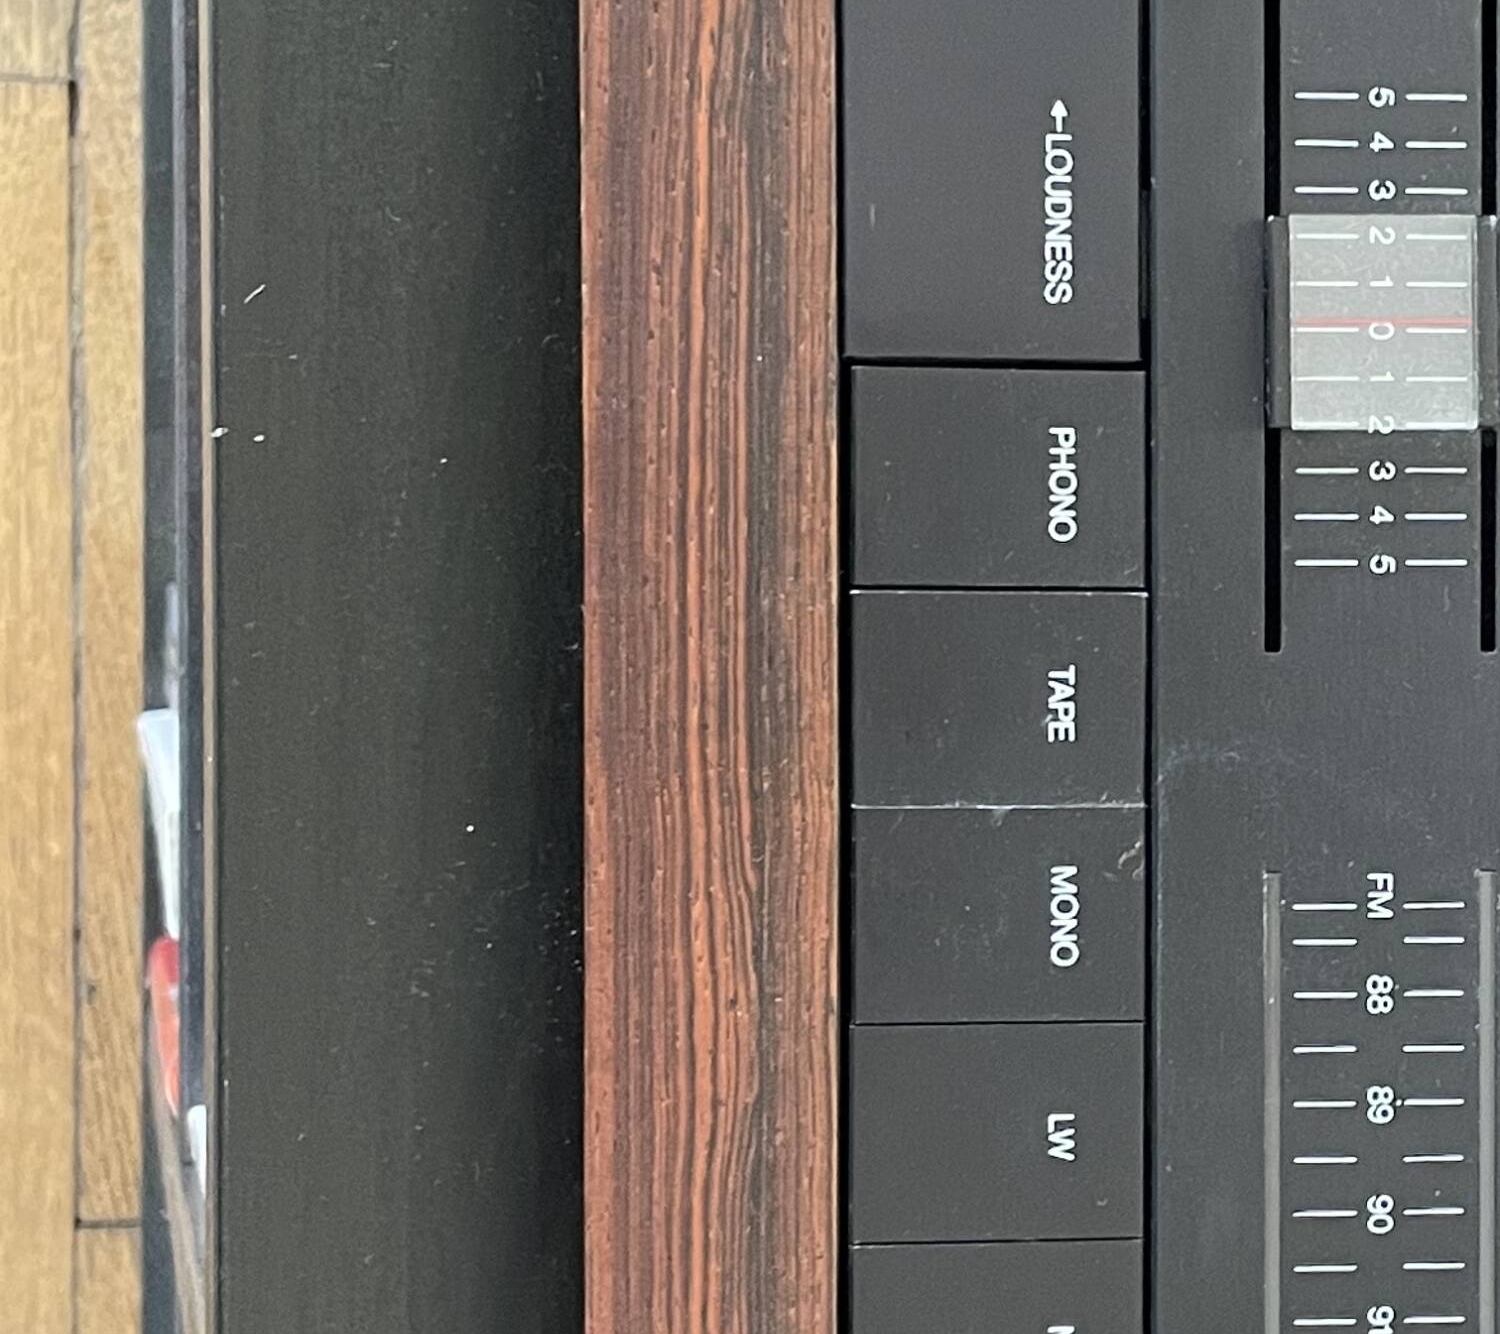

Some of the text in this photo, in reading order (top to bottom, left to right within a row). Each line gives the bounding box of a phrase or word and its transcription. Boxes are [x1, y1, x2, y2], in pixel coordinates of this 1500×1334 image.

[1043, 133, 1074, 305] LOUDNESS
[1368, 86, 1397, 574] 5 4 3 2 1 0 1 2 3 4 5
[1047, 427, 1078, 542] PHONO
[1044, 664, 1076, 743] TAPE
[1050, 865, 1080, 967] MONO
[1366, 872, 1394, 919] FM
[1365, 974, 1394, 1015] 88
[1366, 1085, 1395, 1124] 89
[1047, 1113, 1075, 1161] LW
[1366, 1194, 1394, 1234] 90
